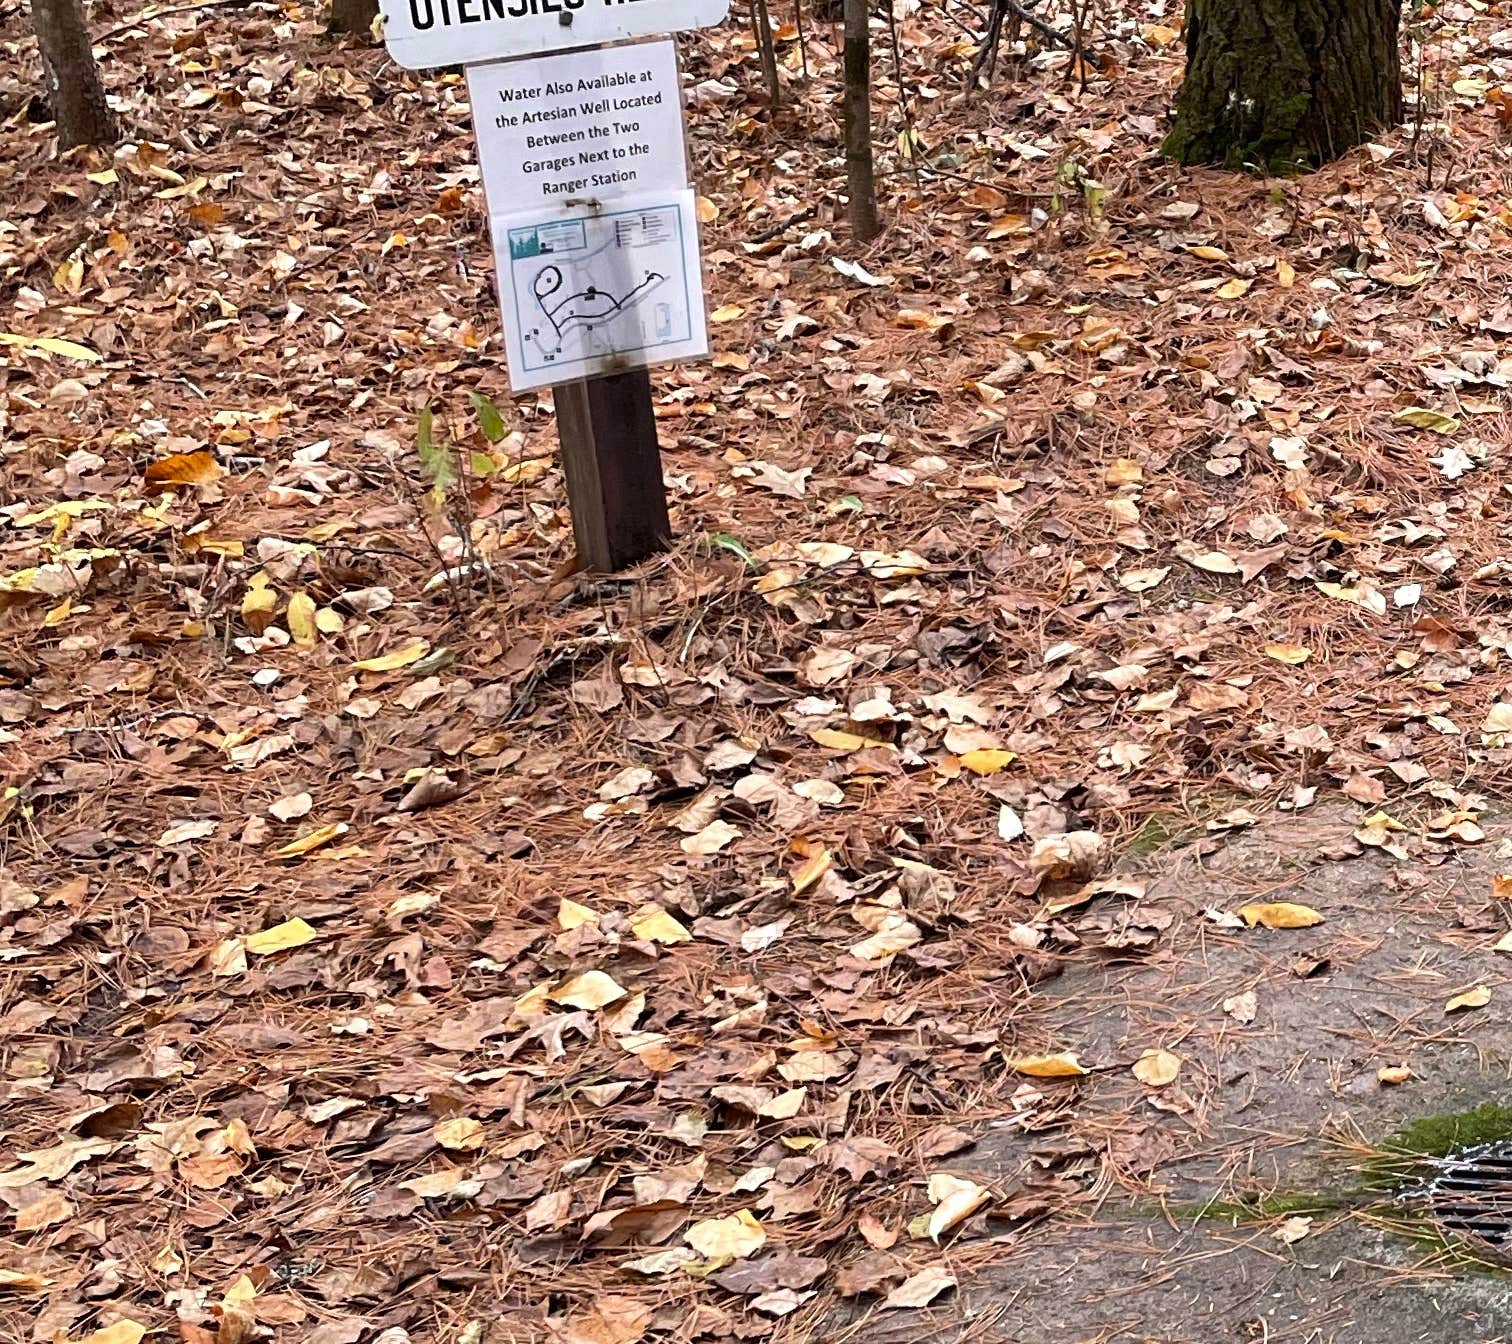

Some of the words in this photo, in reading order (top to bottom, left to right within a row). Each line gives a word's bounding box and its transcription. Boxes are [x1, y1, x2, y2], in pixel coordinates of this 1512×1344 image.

[498, 86, 542, 103] Water
[545, 81, 574, 96] Also
[577, 72, 637, 92] Available
[639, 70, 653, 82] at
[495, 115, 518, 128] the
[522, 107, 577, 125] Artesian
[579, 99, 610, 115] Well
[613, 91, 662, 111] Located
[526, 129, 585, 149] Between
[588, 126, 610, 139] the
[612, 121, 640, 136] Two
[522, 156, 576, 174] Garages
[578, 150, 610, 165] Next
[612, 147, 626, 159] to
[629, 143, 650, 156] the
[542, 177, 588, 195] Ranger
[591, 169, 637, 186] Station
